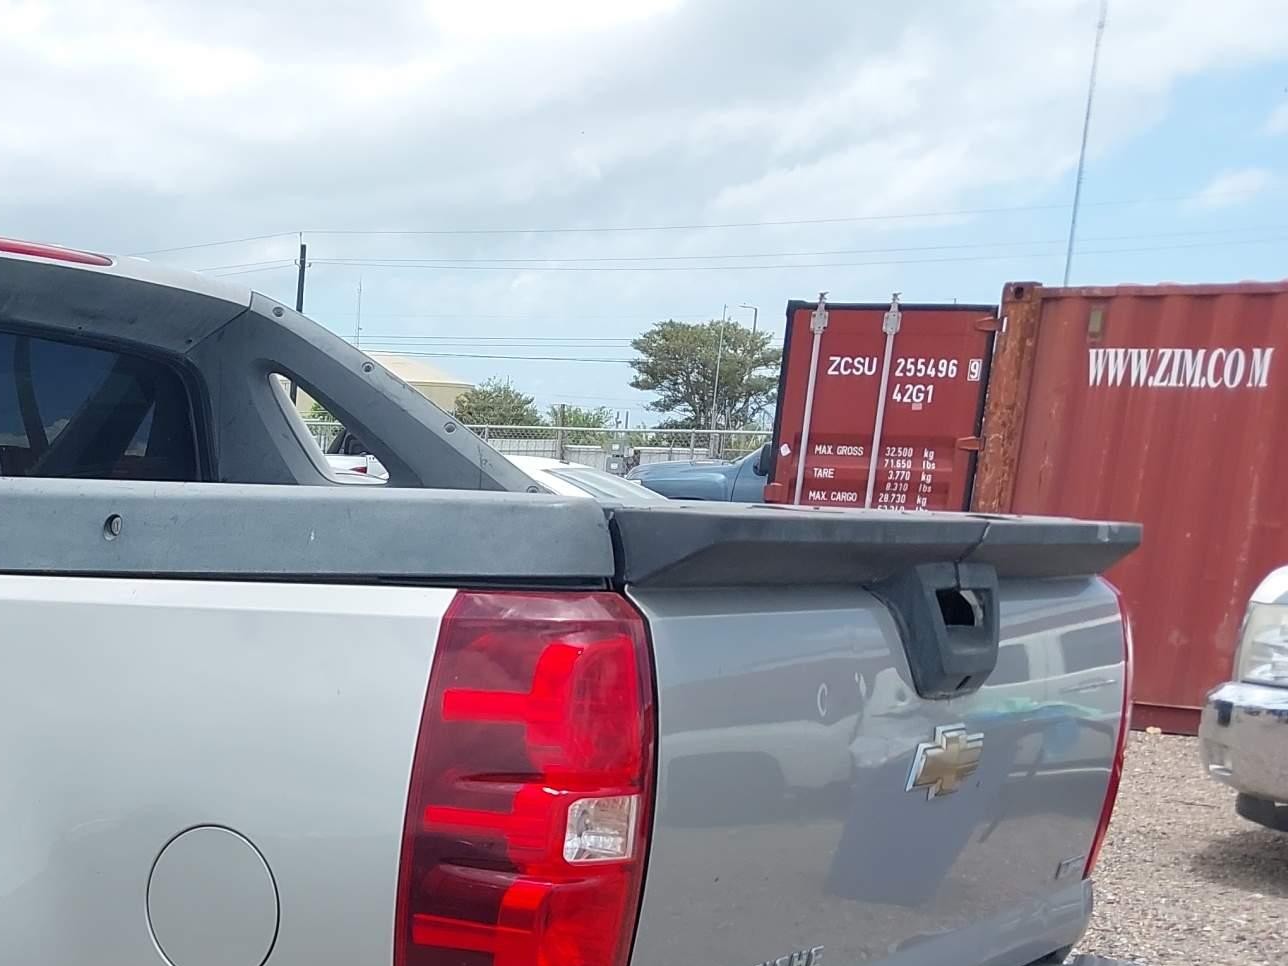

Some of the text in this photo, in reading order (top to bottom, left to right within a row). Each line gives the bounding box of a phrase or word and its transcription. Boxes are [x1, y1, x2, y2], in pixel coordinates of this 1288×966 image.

[827, 356, 981, 380] ZCSU 255496 9
[892, 384, 934, 403] 42G1
[836, 445, 864, 456] GROSS
[885, 447, 913, 457] 32.500
[923, 448, 935, 460] kg
[884, 459, 936, 470] 71.650 lbs
[813, 468, 932, 483] TARE 3.770 kg
[918, 483, 932, 493] lbs
[830, 491, 858, 502] CARGO
[916, 495, 927, 507] kg
